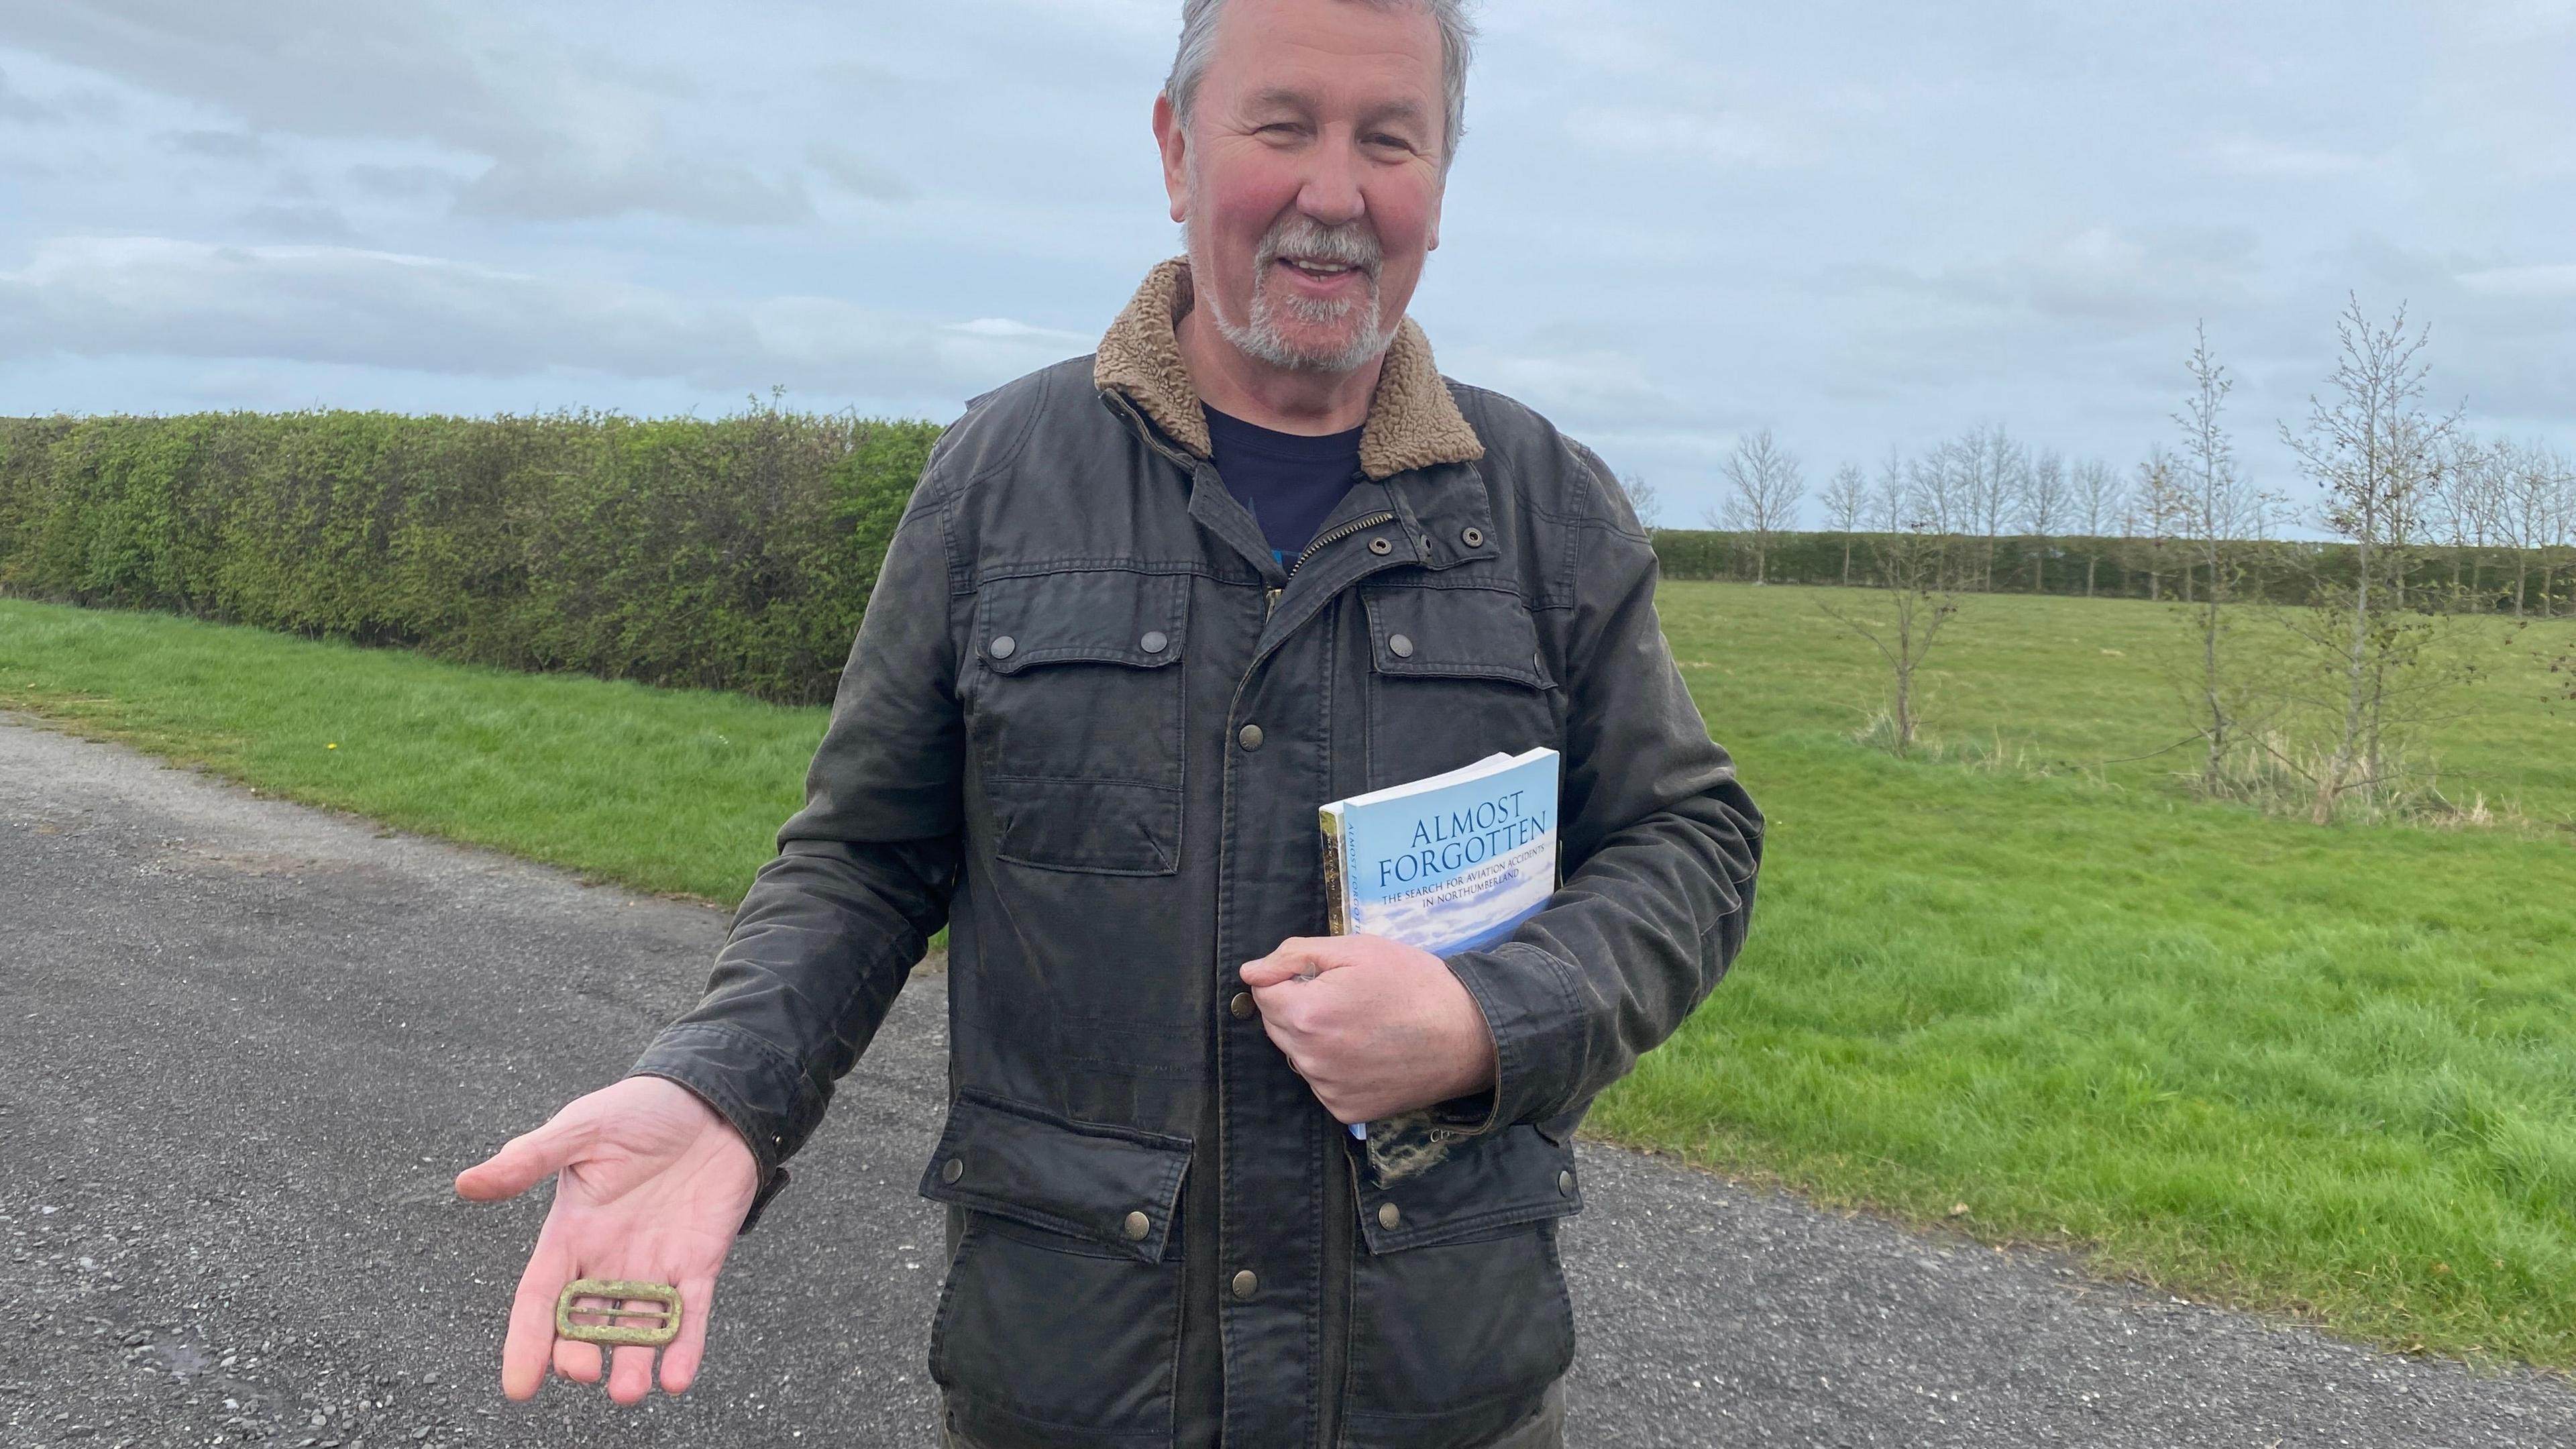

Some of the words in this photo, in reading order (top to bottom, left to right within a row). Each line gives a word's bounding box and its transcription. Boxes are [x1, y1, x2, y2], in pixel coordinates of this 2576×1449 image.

[1347, 822, 1356, 869] ALMOST
[1378, 810, 1546, 888] FORGOTTEN
[1411, 790, 1523, 849] ALMOST
[1381, 892, 1402, 905] THE
[1405, 881, 1444, 900] SEARCH
[1446, 875, 1464, 890] FOR
[1466, 863, 1505, 883] AVIATION
[1507, 843, 1546, 869] ACCIDENTS
[1422, 896, 1434, 908] IN
[1437, 868, 1519, 904] NORTHUMBERLAND
